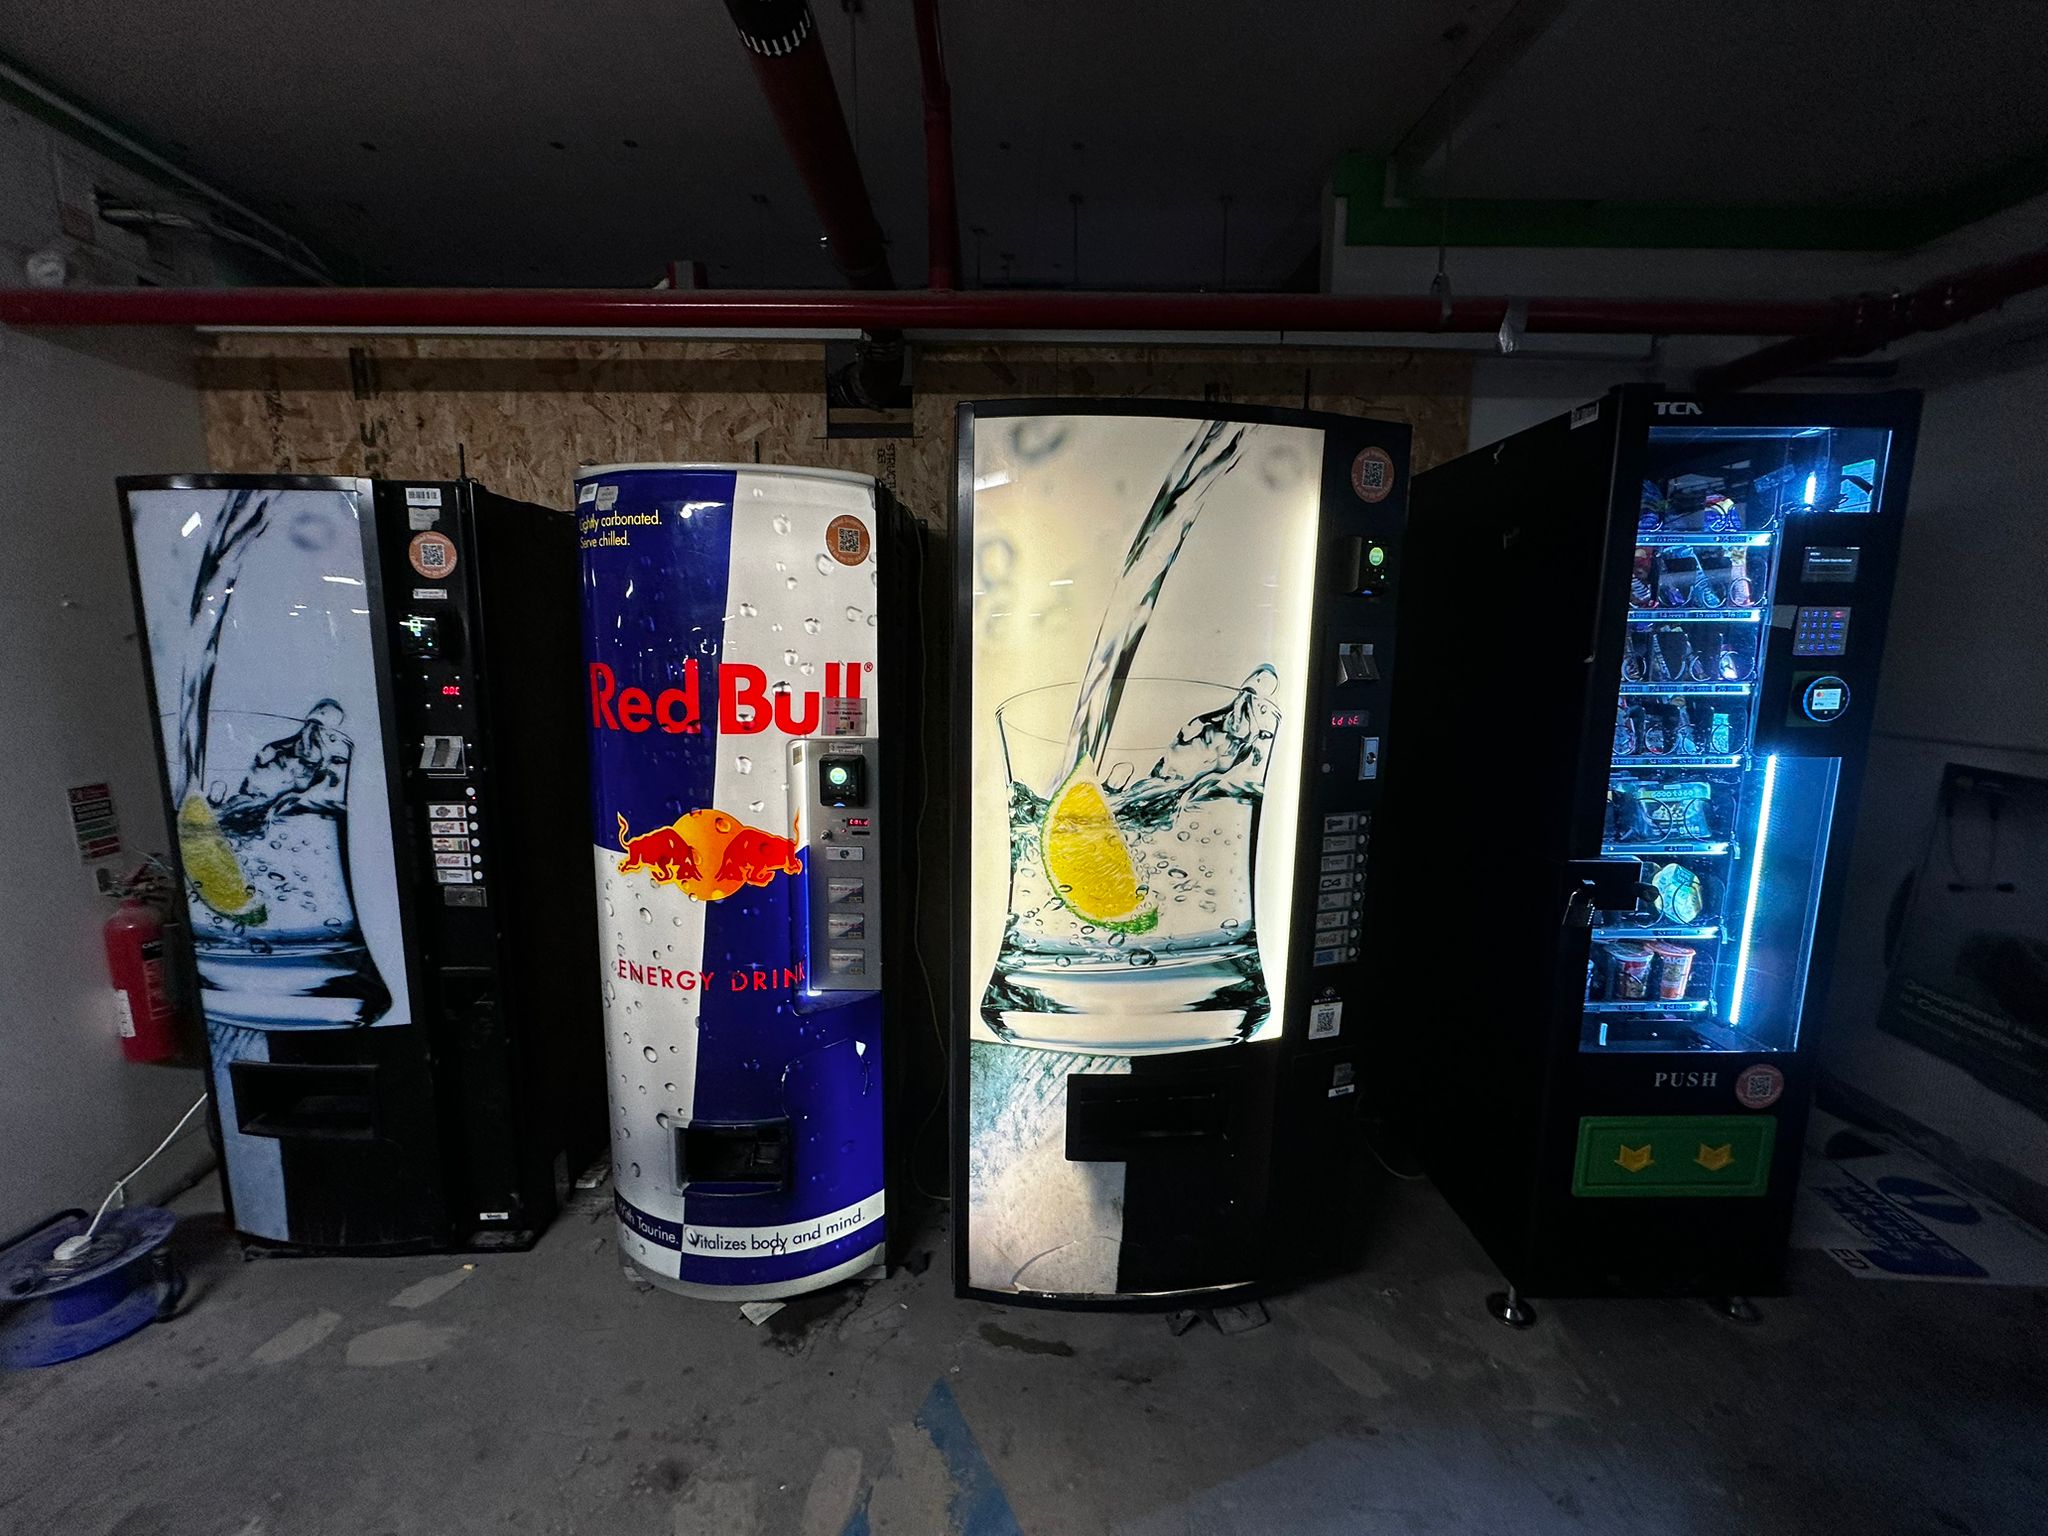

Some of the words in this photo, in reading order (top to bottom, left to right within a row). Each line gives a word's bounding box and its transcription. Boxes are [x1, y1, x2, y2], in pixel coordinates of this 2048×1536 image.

[600, 509, 662, 527] carbonated.
[579, 536, 598, 549] Serve
[598, 529, 631, 547] chilled.
[588, 657, 701, 734] Red
[617, 958, 715, 992] ENERGY
[731, 960, 806, 992] DRINK
[1654, 1072, 1718, 1088] PUSH
[636, 1214, 680, 1245] Taurine.
[687, 1231, 747, 1251] Vitalizes
[751, 1232, 788, 1252] body
[792, 1224, 822, 1245] and
[825, 1208, 865, 1235] mind.
